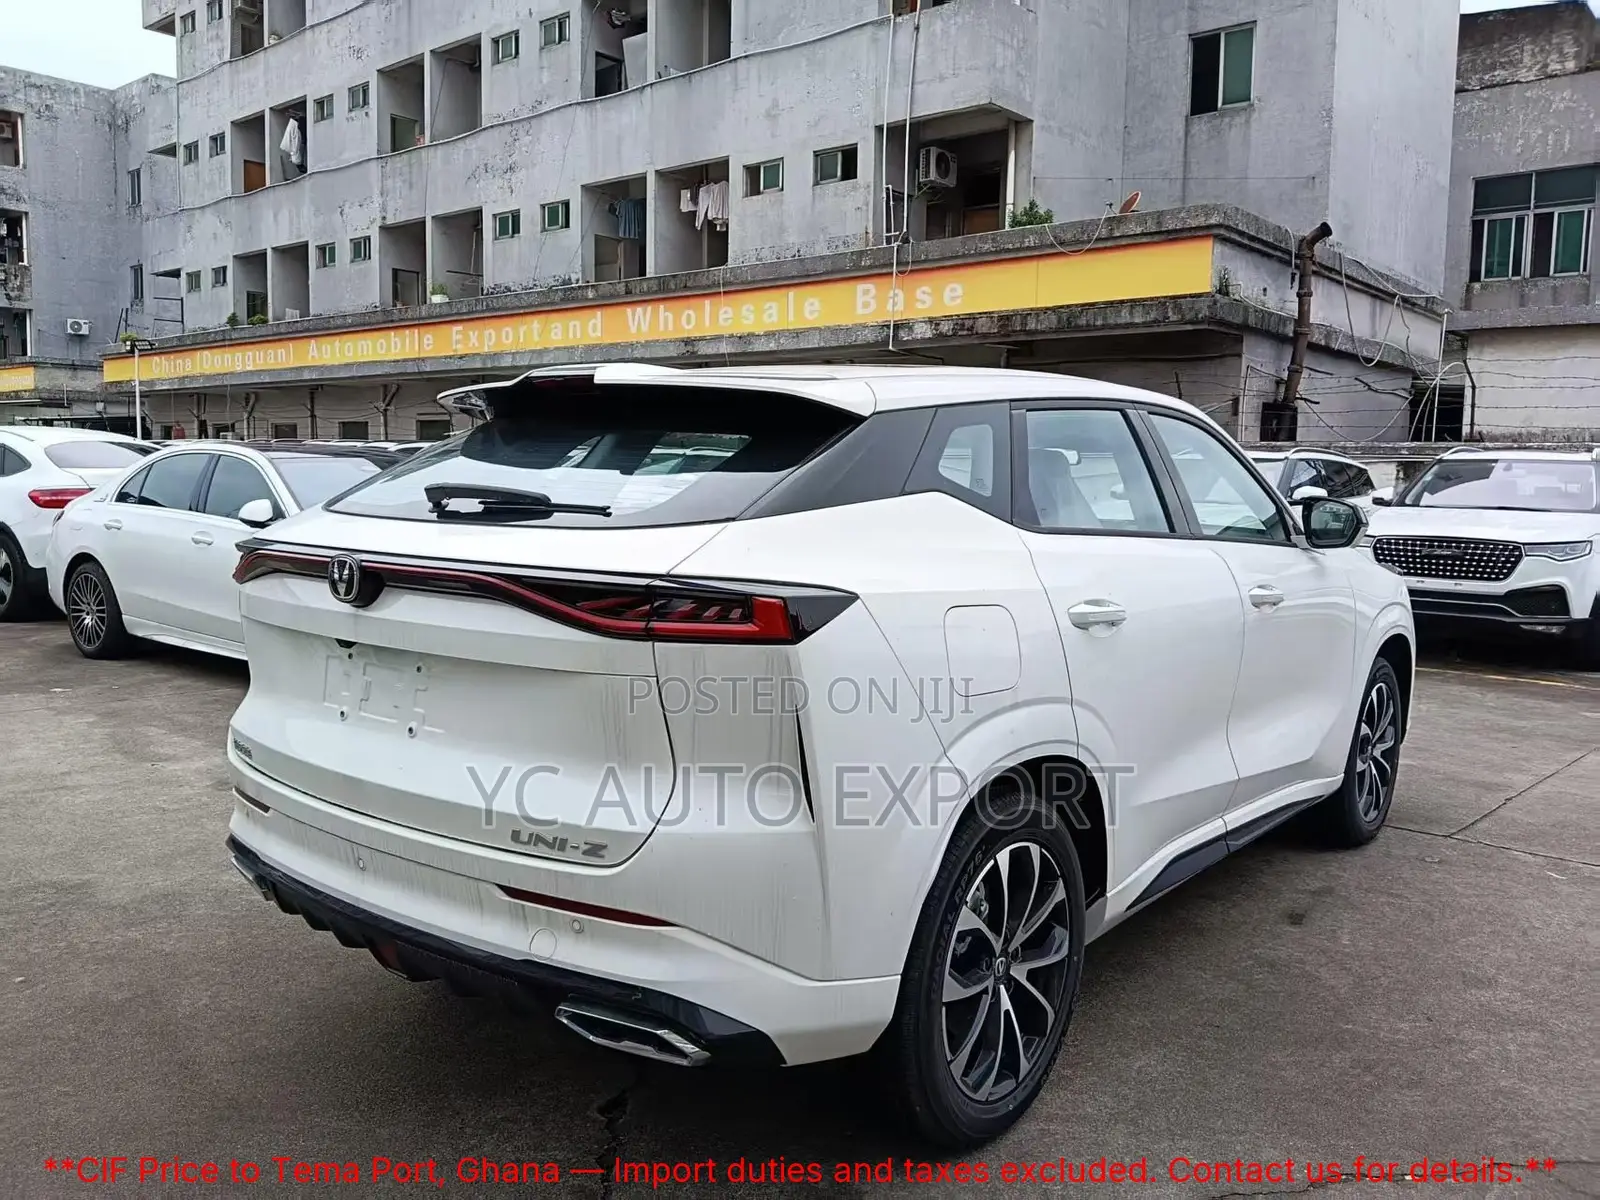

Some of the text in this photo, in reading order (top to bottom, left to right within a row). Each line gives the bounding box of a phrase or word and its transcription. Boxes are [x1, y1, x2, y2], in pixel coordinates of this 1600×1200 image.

[152, 356, 192, 374] China
[308, 330, 434, 362] Automobile
[451, 318, 540, 352] Export
[550, 311, 602, 341] and
[626, 291, 821, 334] Wholesale
[855, 281, 965, 316] Base
[510, 828, 608, 859] UNI-Z
